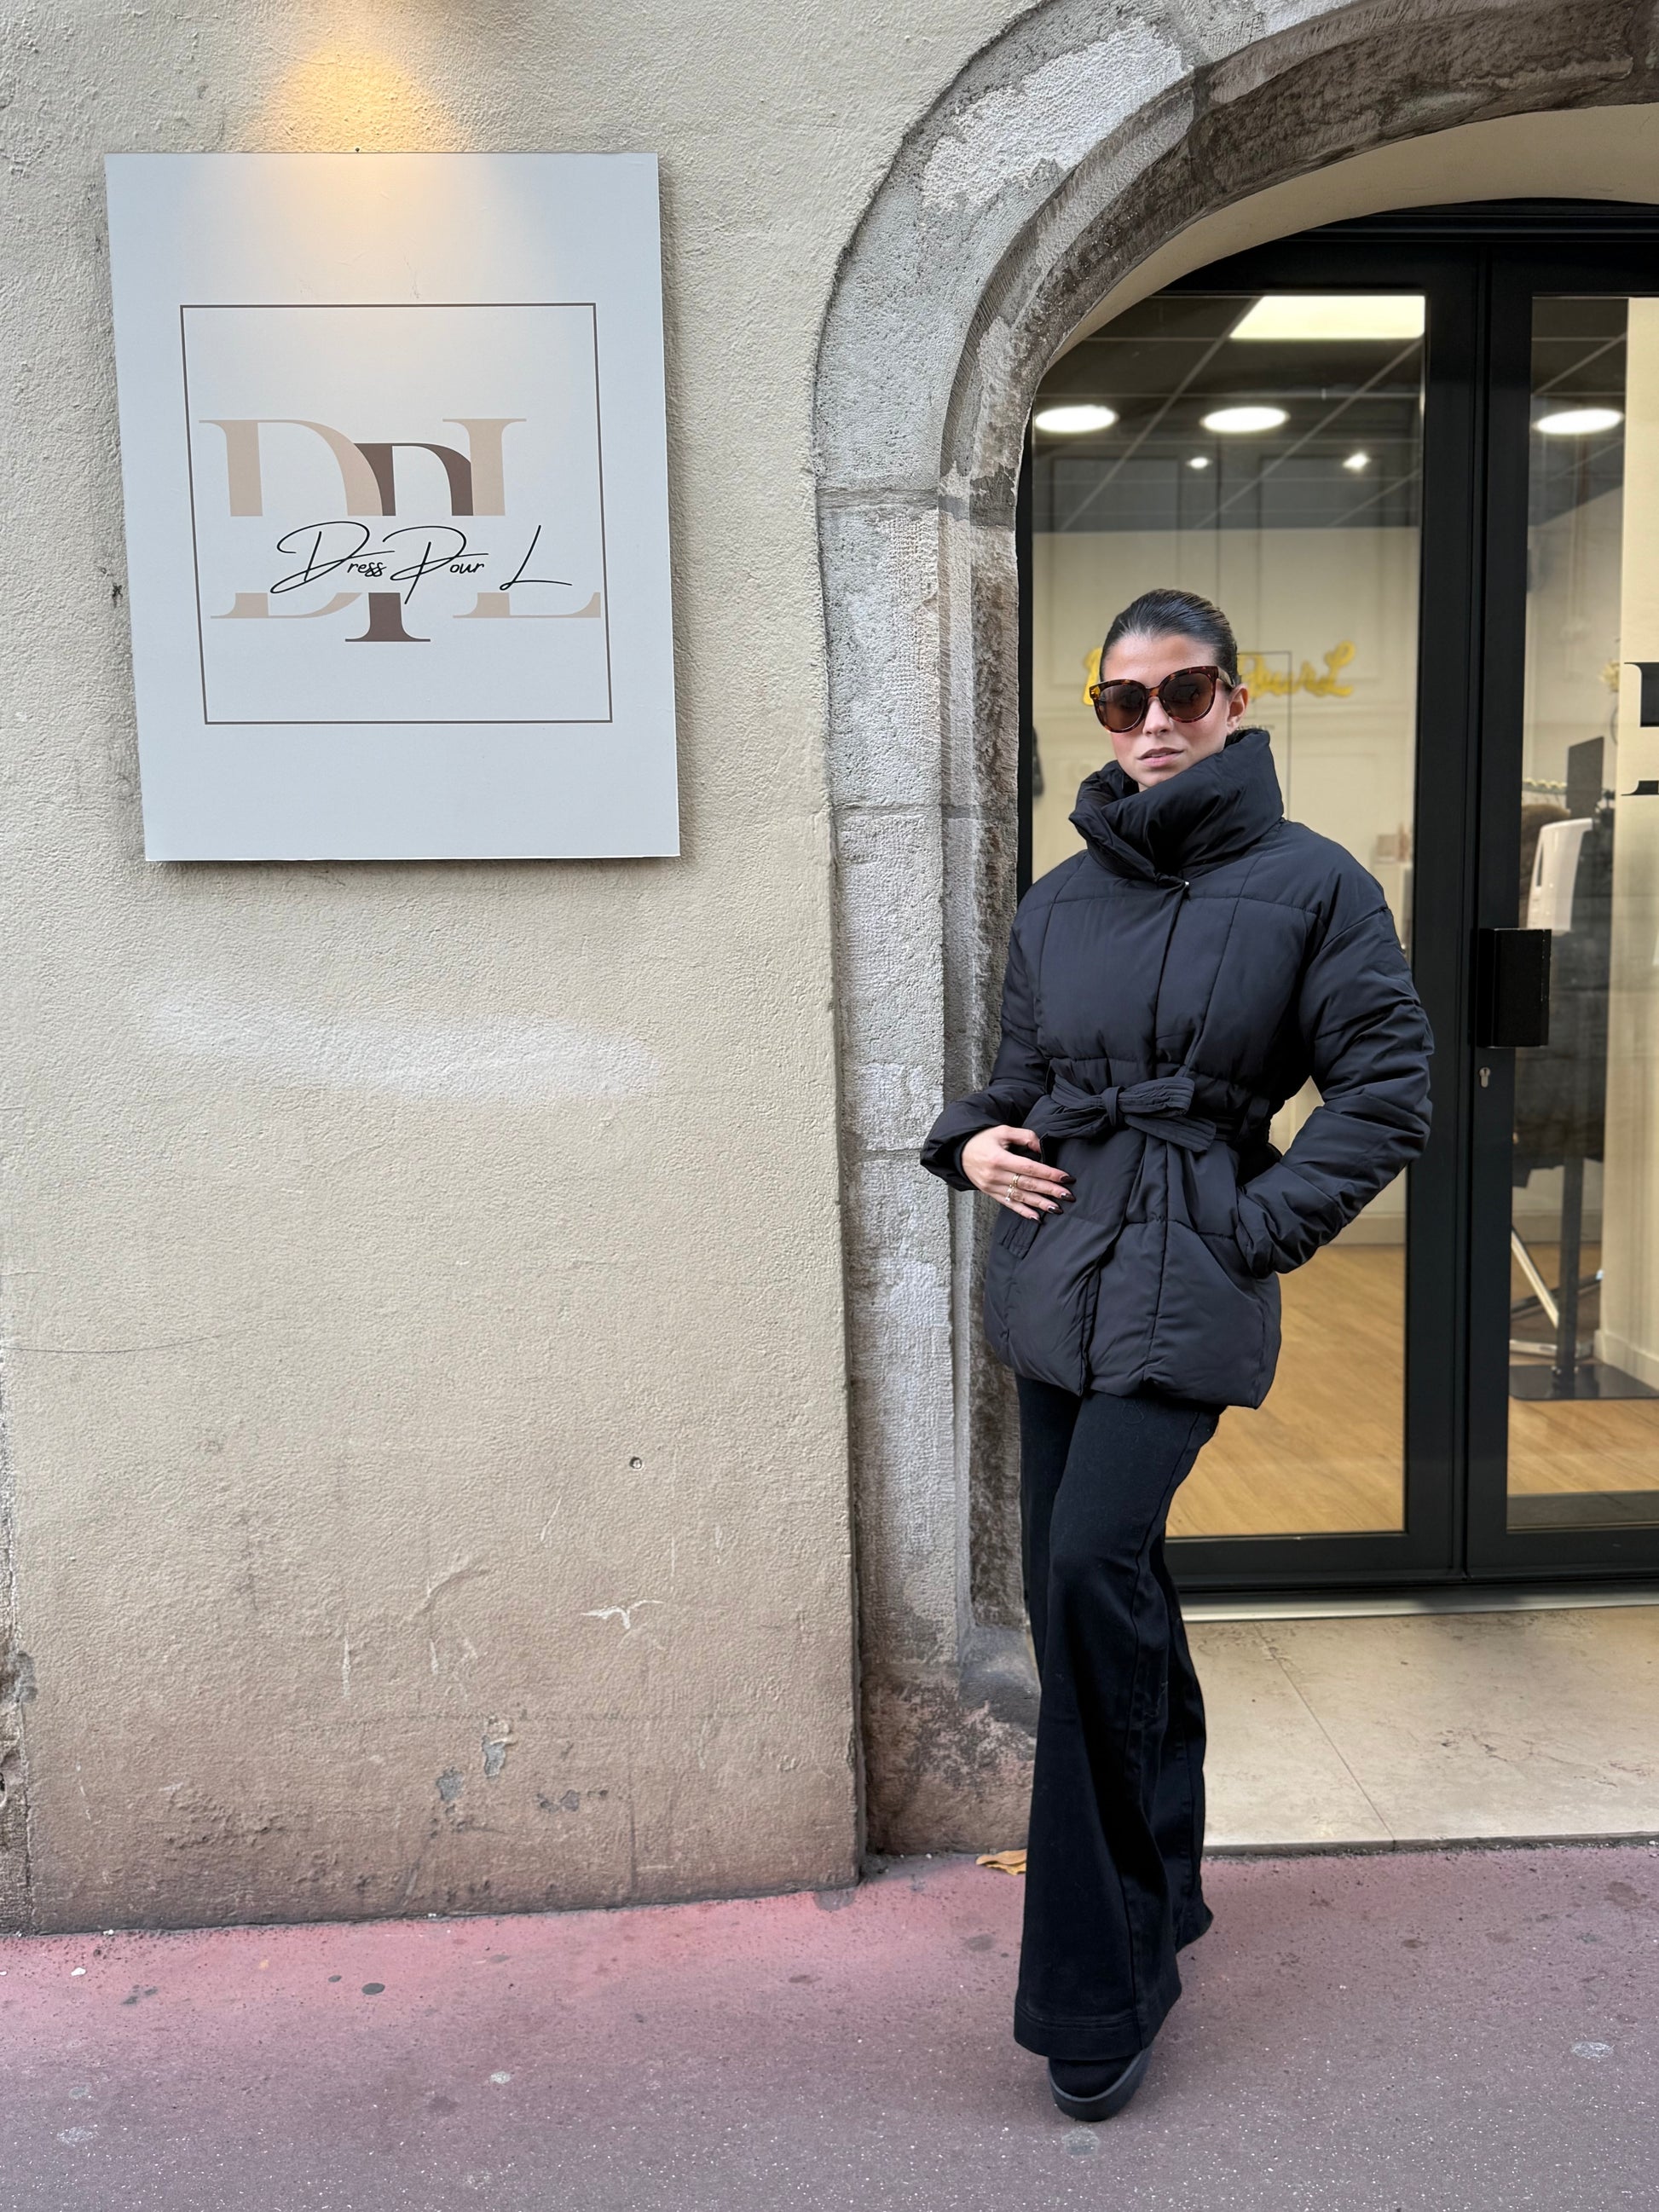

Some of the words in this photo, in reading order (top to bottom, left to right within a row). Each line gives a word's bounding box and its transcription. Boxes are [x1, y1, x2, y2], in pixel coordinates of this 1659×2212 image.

[269, 521, 395, 594] Dress
[382, 525, 489, 605] Pour
[500, 524, 572, 591] L
